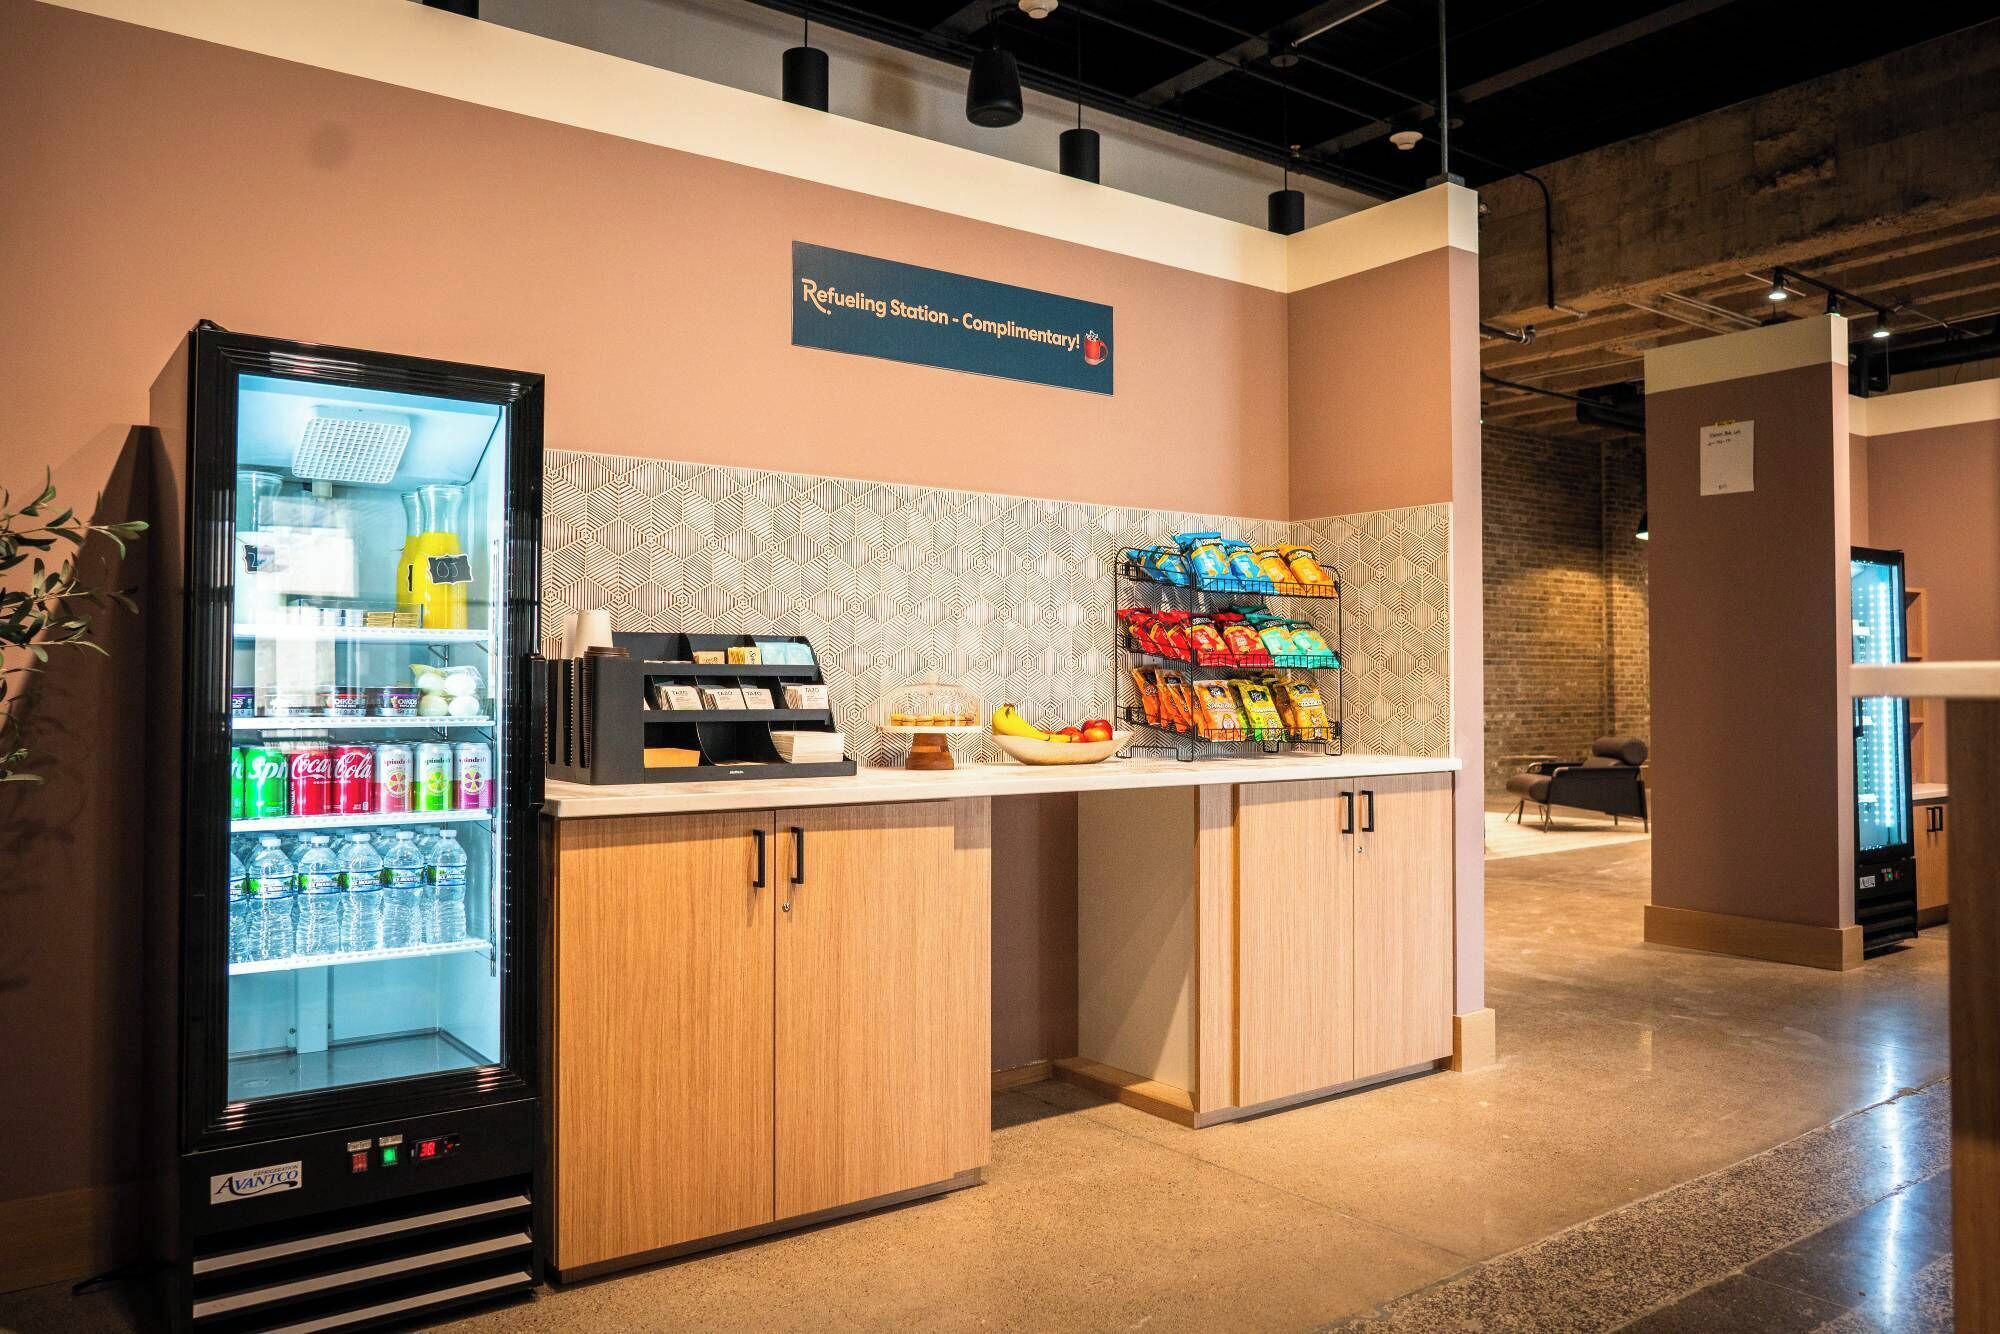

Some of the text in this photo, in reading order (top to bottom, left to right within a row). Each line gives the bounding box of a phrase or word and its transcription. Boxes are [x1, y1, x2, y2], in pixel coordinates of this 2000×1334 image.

[801, 278, 887, 318] Refueling
[890, 299, 948, 325] Station
[962, 313, 1080, 351] Complimentary!
[214, 1169, 299, 1195] AVANTCO
